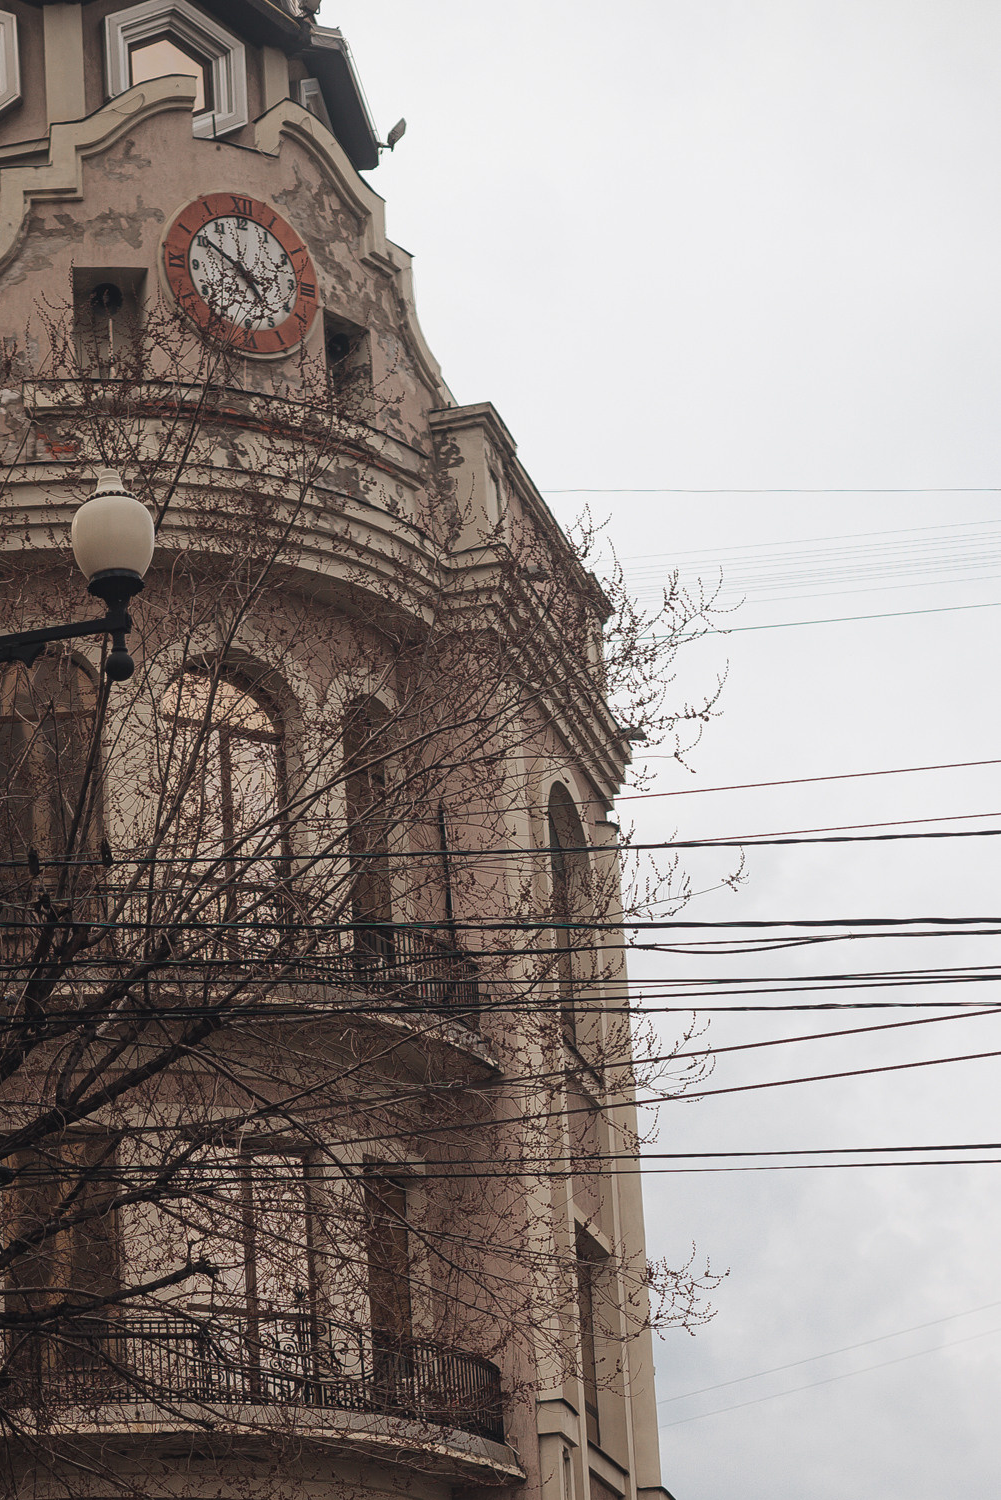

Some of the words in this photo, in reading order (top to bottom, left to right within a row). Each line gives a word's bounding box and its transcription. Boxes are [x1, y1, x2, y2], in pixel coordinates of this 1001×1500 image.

[230, 196, 253, 216] XII
[214, 221, 226, 235] 11
[236, 217, 248, 231] 12
[263, 231, 269, 244] 1
[191, 258, 200, 270] 9
[287, 279, 295, 291] 3
[267, 317, 276, 328] 5
